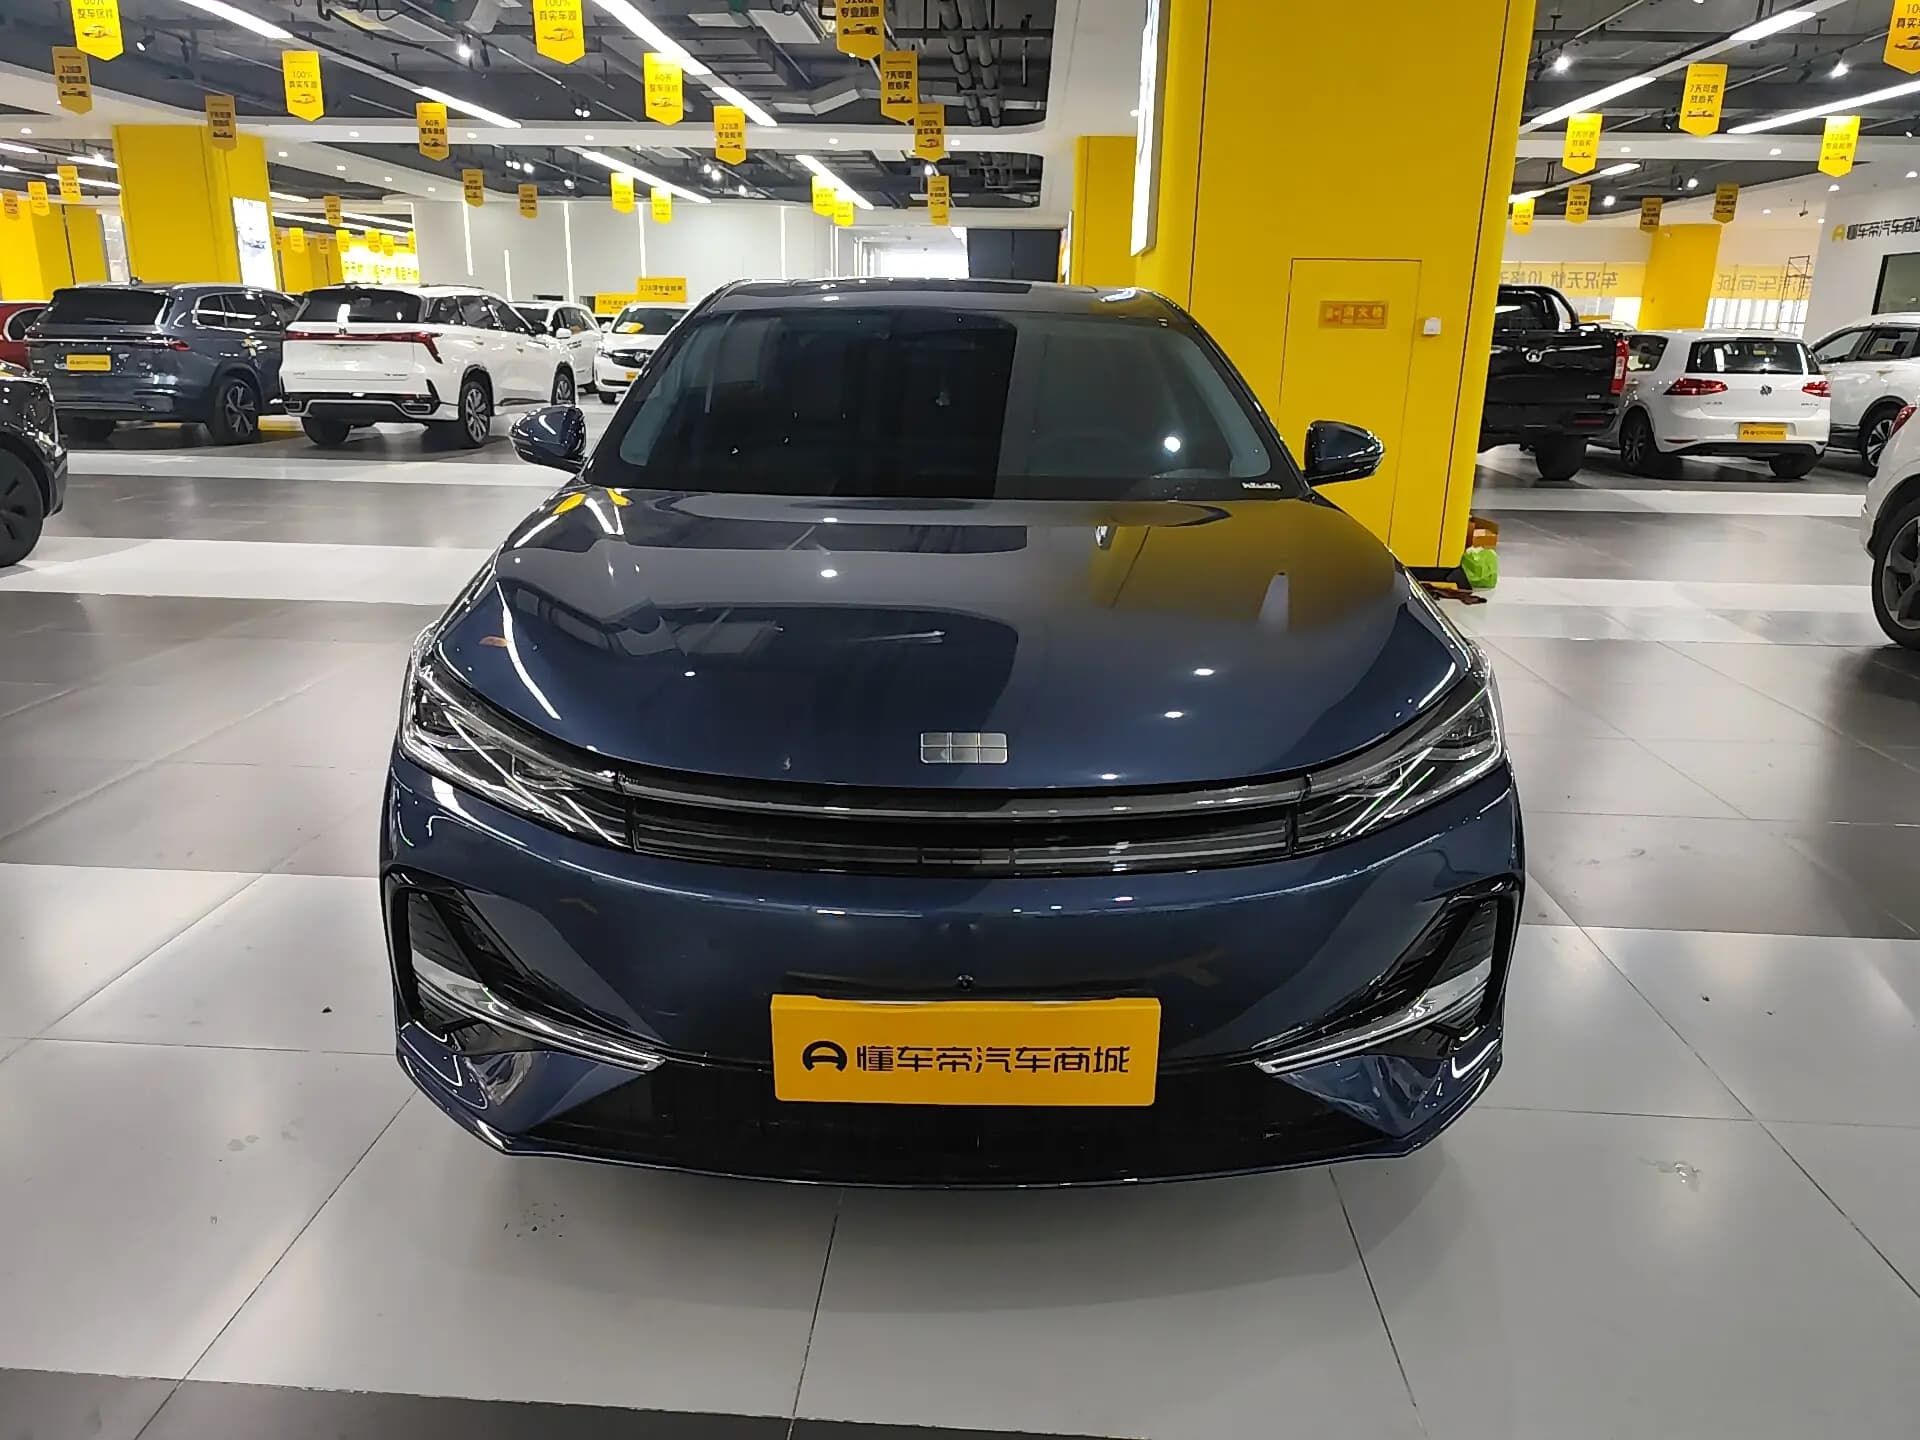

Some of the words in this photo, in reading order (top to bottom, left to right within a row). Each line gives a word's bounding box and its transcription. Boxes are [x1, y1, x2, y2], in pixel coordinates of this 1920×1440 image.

[857, 1045, 1131, 1073] 懂车帝汽车商城
